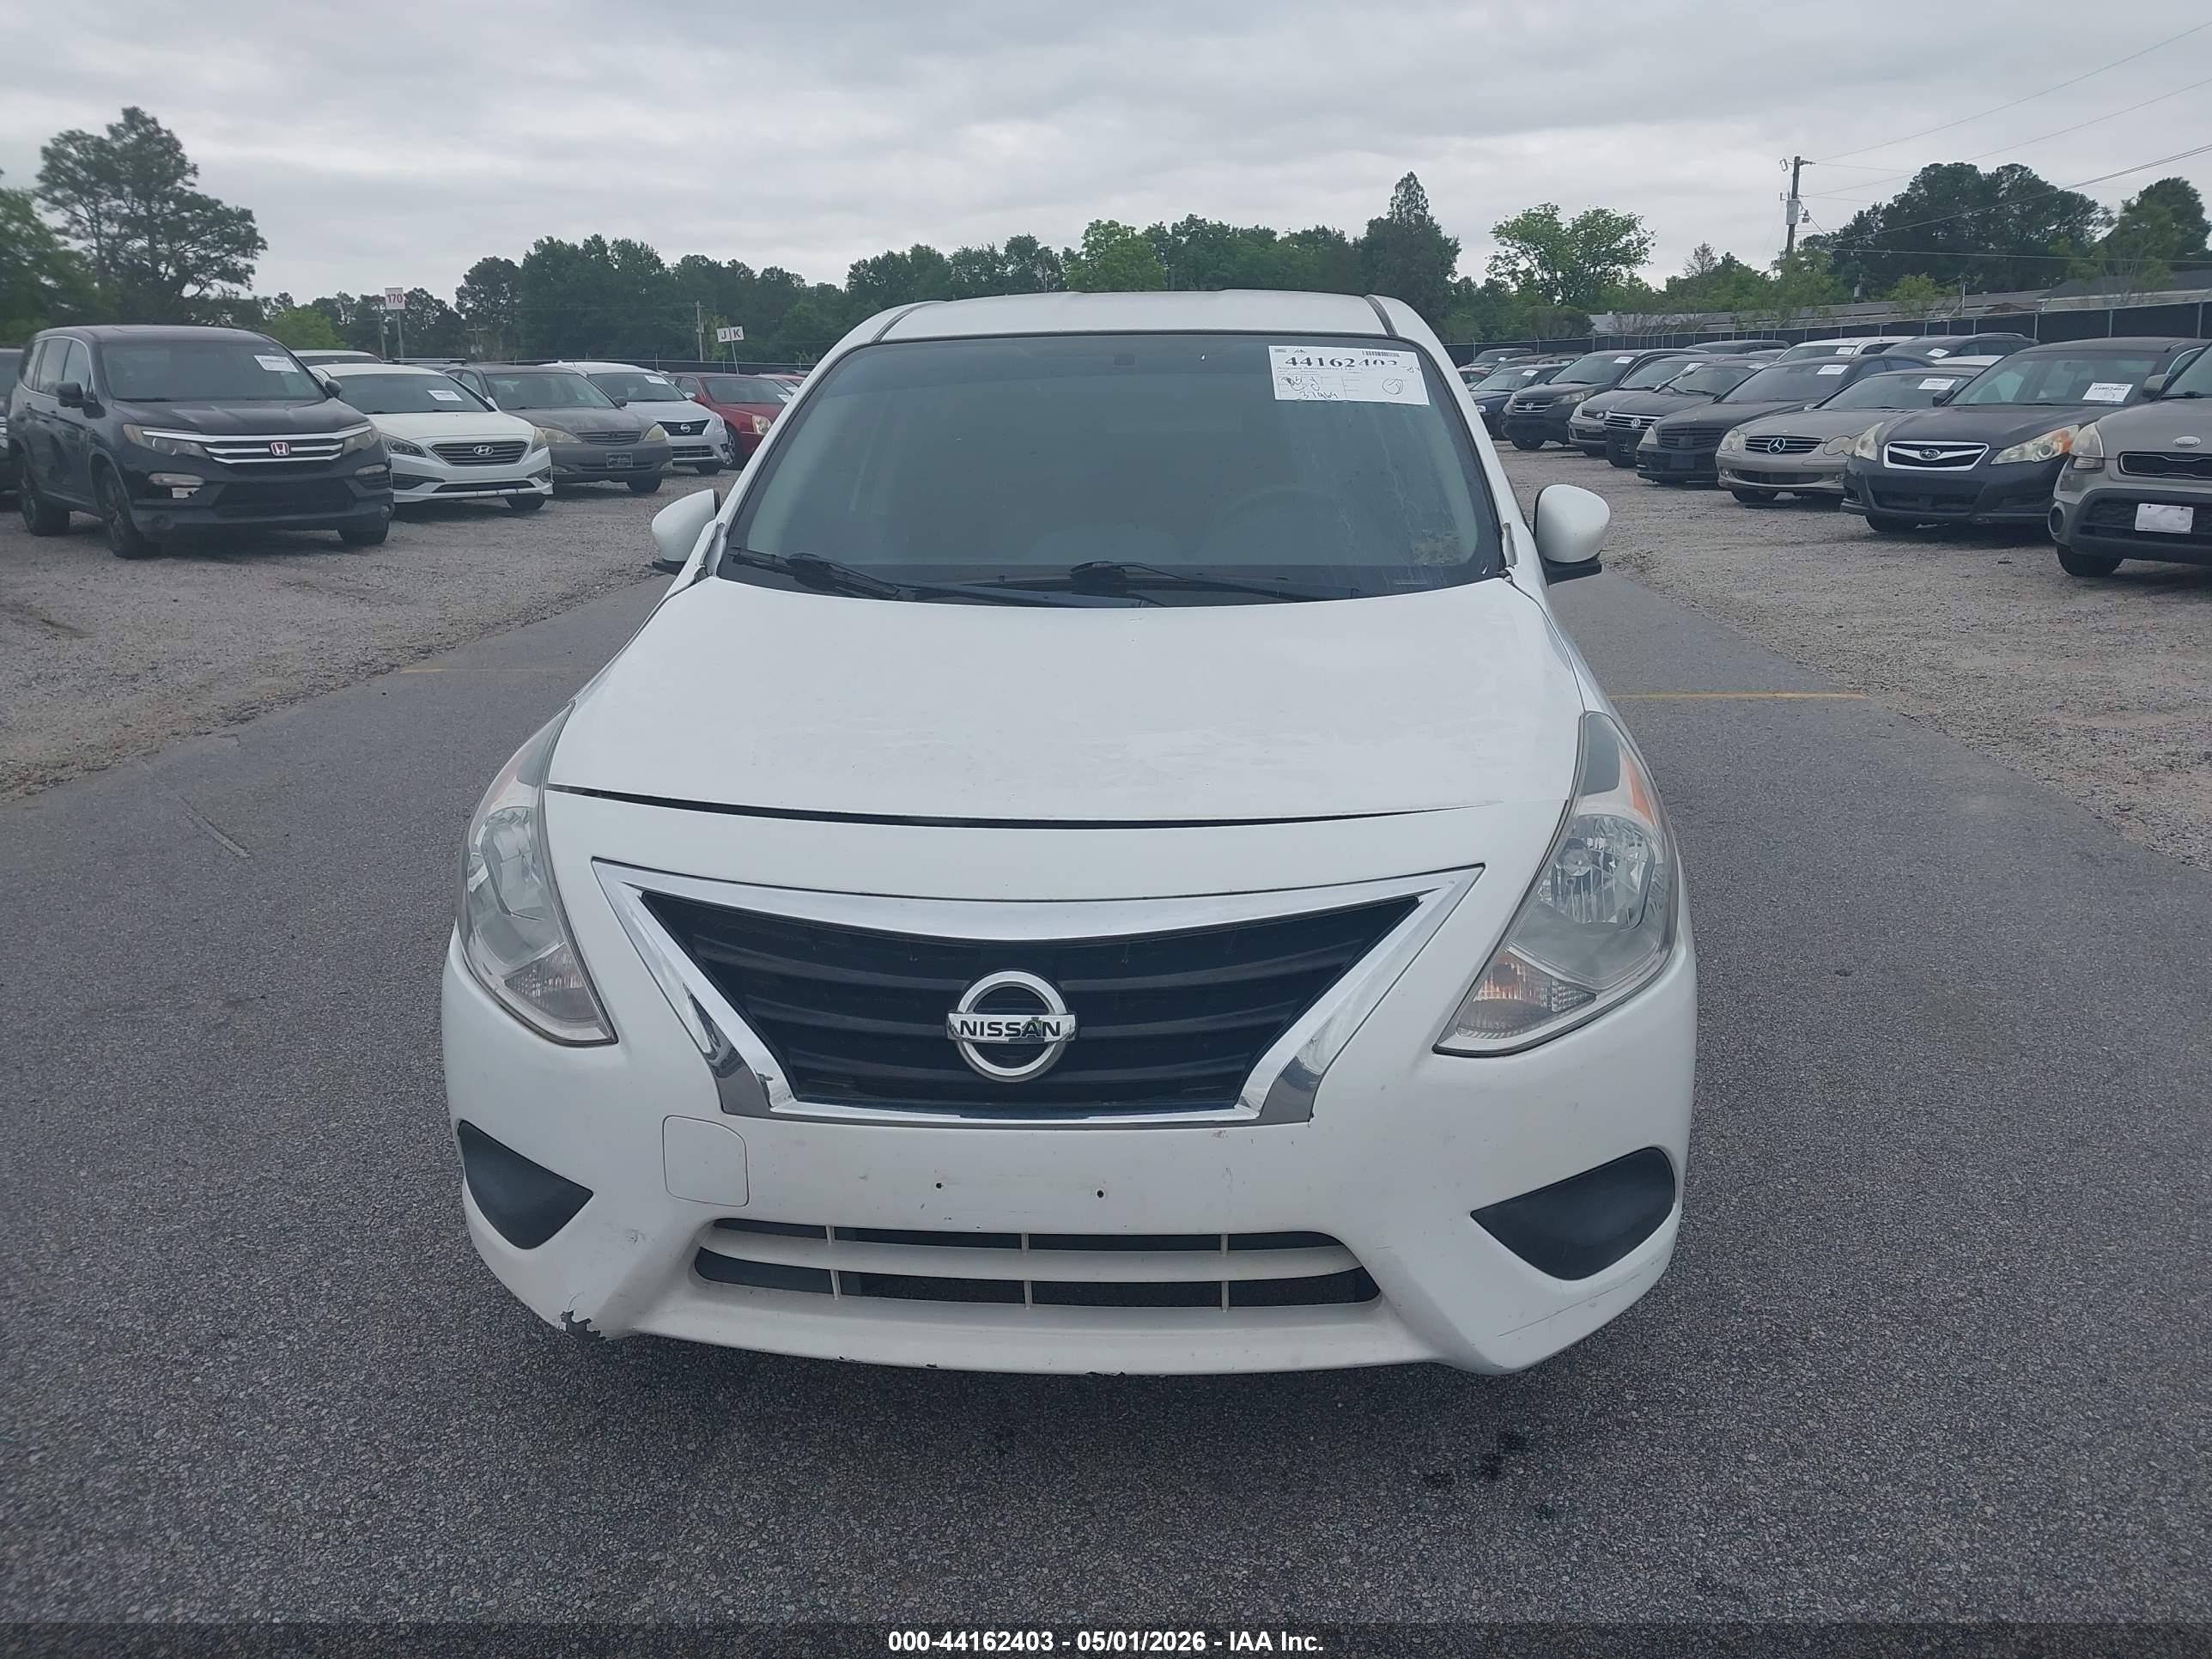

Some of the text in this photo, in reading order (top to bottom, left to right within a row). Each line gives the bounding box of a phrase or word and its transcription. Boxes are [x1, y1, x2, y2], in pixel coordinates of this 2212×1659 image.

[386, 294, 403, 303] 170
[721, 331, 726, 340] J
[732, 329, 741, 338] K
[960, 1020, 1060, 1037] NISSAN
